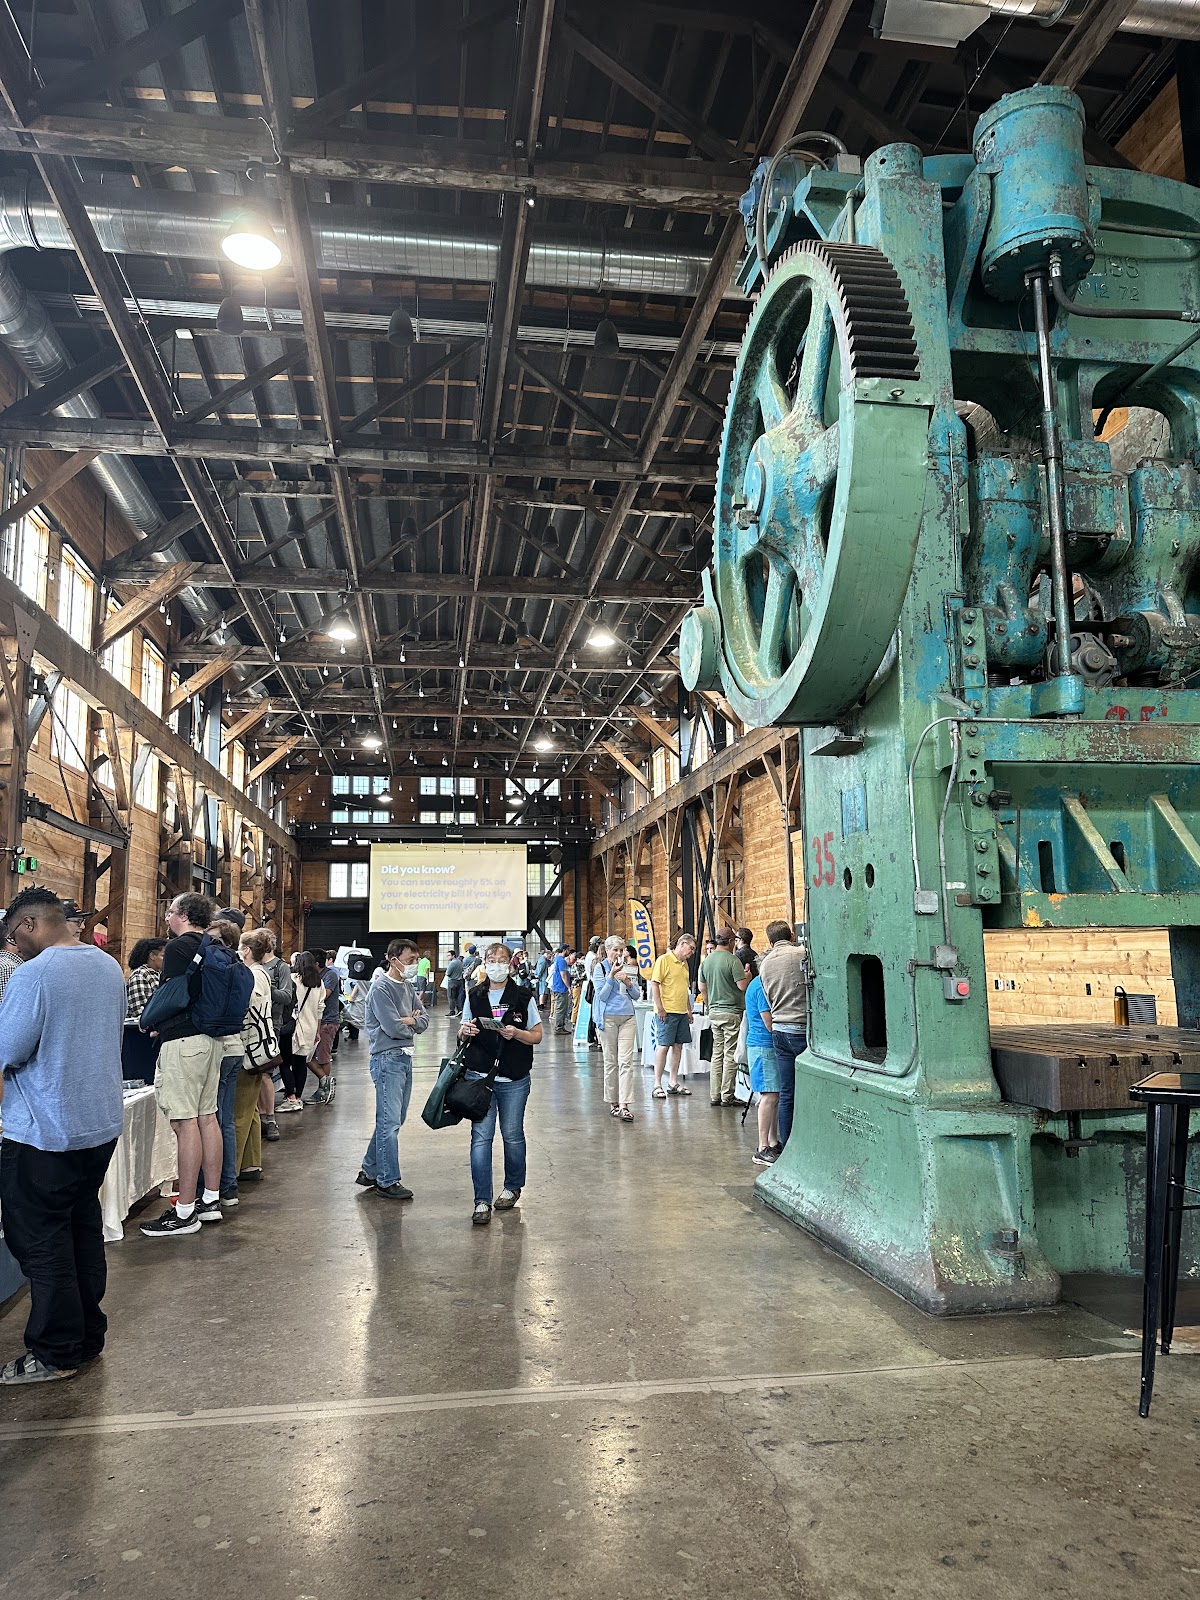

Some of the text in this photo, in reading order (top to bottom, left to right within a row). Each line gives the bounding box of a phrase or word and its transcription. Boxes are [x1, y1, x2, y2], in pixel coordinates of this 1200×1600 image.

[812, 831, 836, 889] 35
[381, 865, 456, 876] Did you know?
[381, 878, 399, 886] You
[443, 877, 479, 888] roughly
[480, 878, 493, 886] 5%
[381, 891, 402, 900] your
[403, 889, 450, 900] electricity
[451, 889, 465, 898] bill
[475, 890, 492, 900] you
[492, 889, 512, 900] sign
[381, 902, 490, 912] up for community solar.
[634, 909, 652, 969] SOLAR
